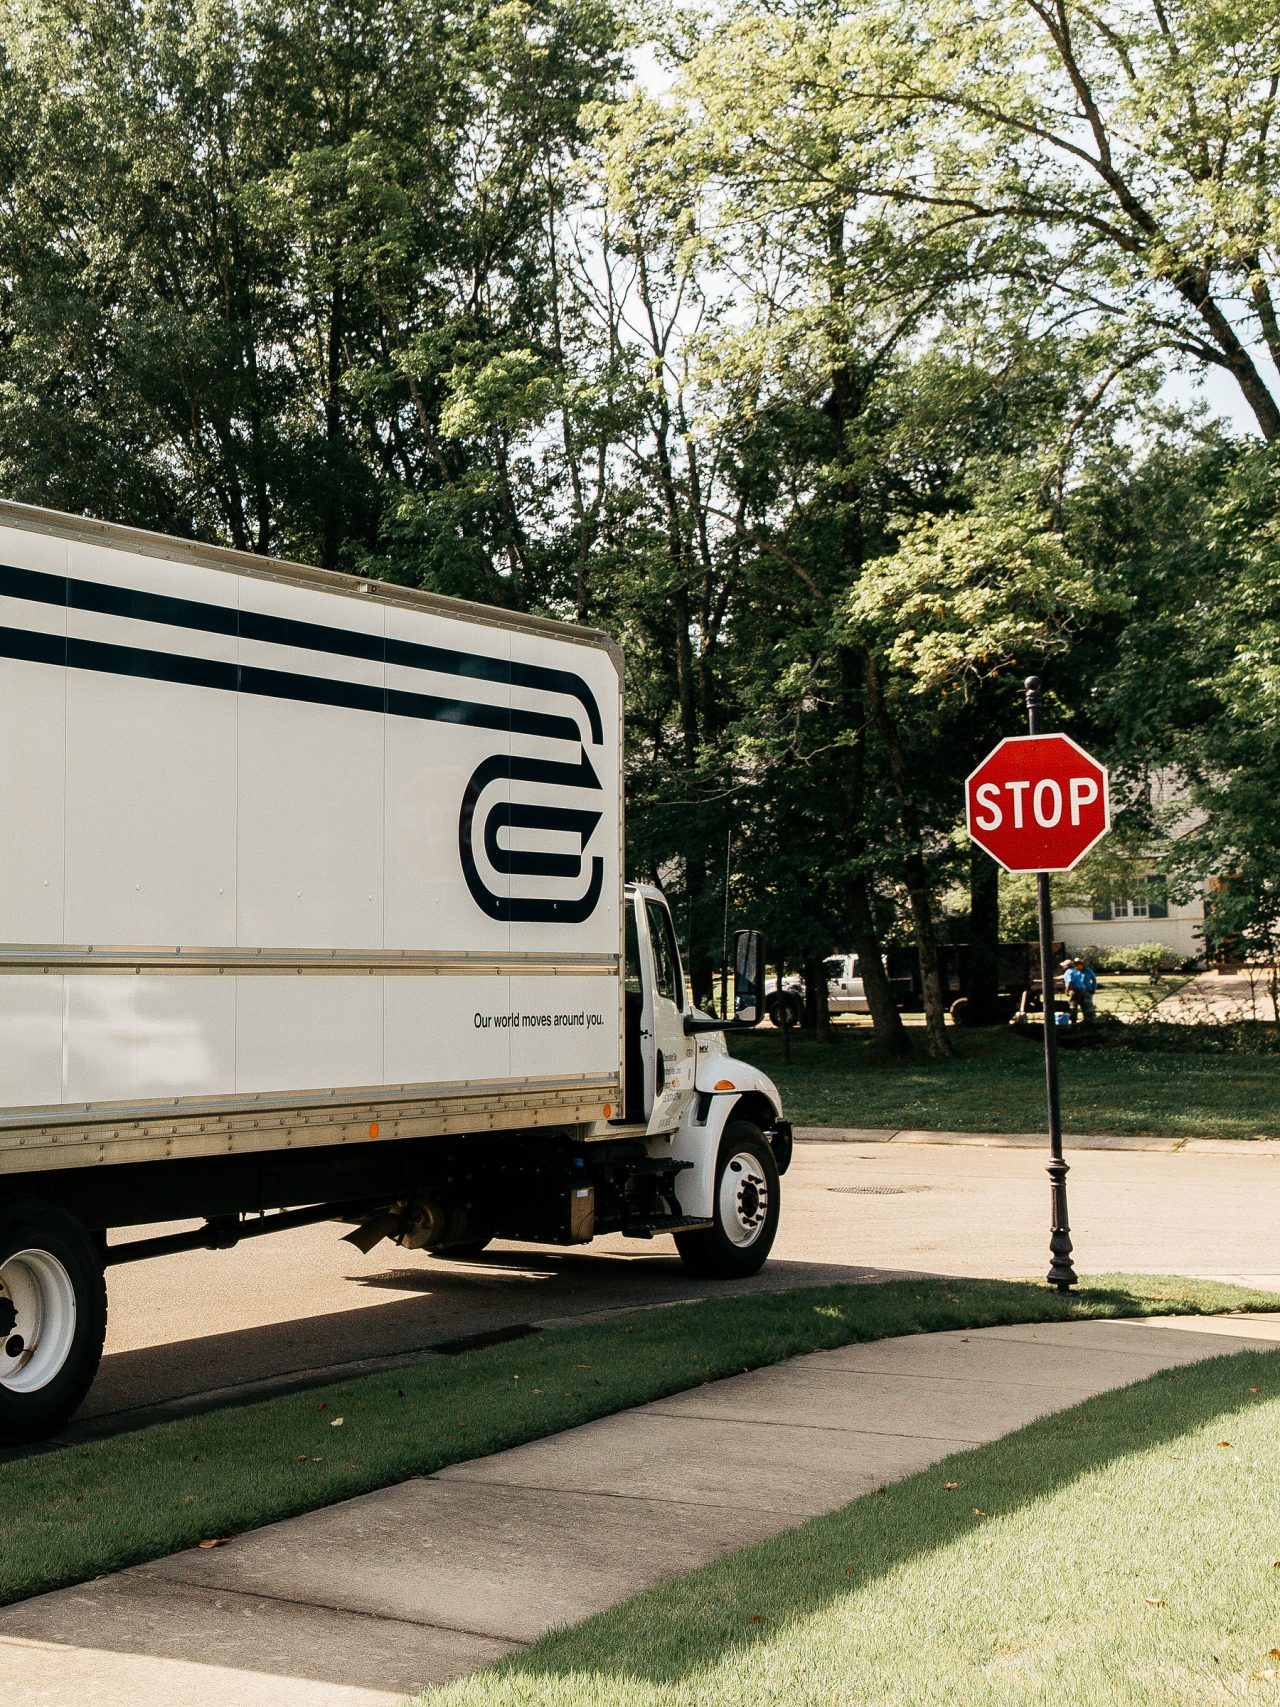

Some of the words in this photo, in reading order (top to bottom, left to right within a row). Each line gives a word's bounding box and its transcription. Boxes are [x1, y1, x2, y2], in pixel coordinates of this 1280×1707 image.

[975, 777, 1098, 831] STOP
[473, 1012, 492, 1028] Our
[493, 1012, 520, 1028] world
[521, 1013, 552, 1027] moves
[553, 1011, 585, 1026] around
[586, 1014, 604, 1029] you.
